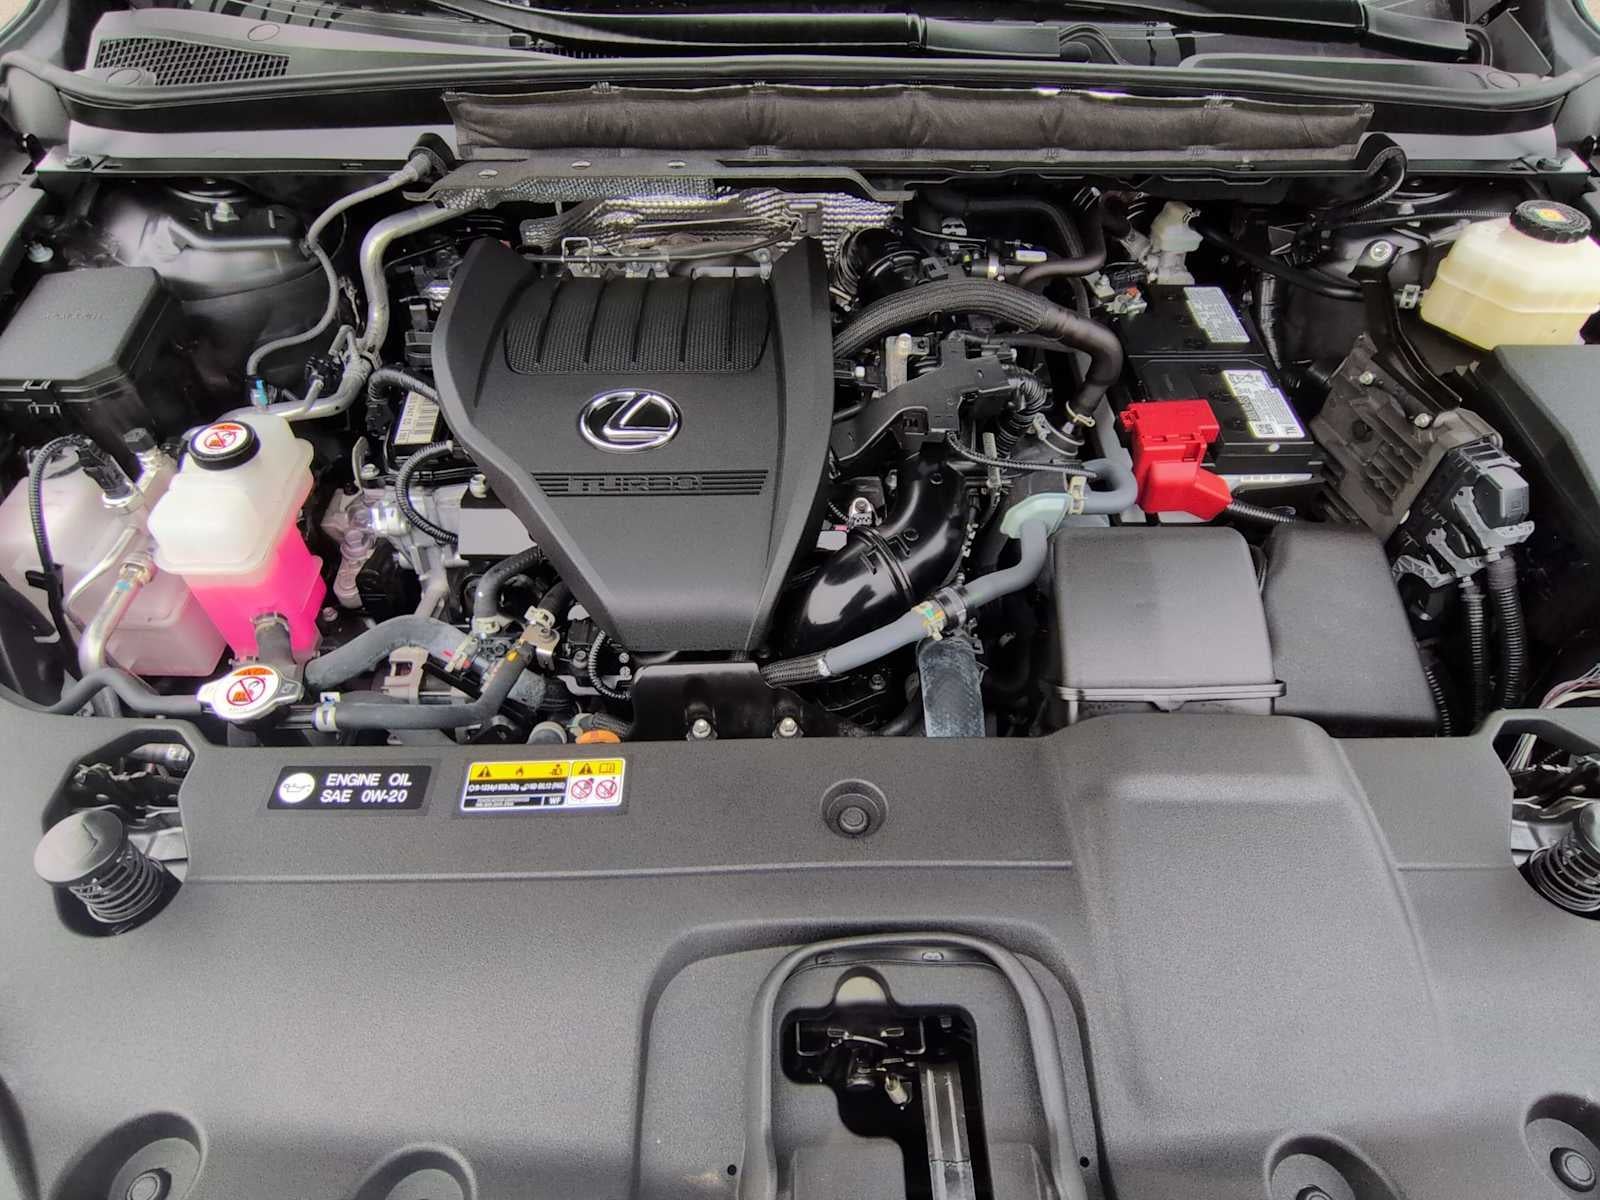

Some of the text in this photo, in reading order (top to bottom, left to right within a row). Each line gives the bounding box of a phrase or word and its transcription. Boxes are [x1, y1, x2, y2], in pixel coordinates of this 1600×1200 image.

[571, 475, 698, 493] TURBO
[325, 773, 412, 786] ENGINE OIL
[320, 789, 408, 803] SAE 0W-20
